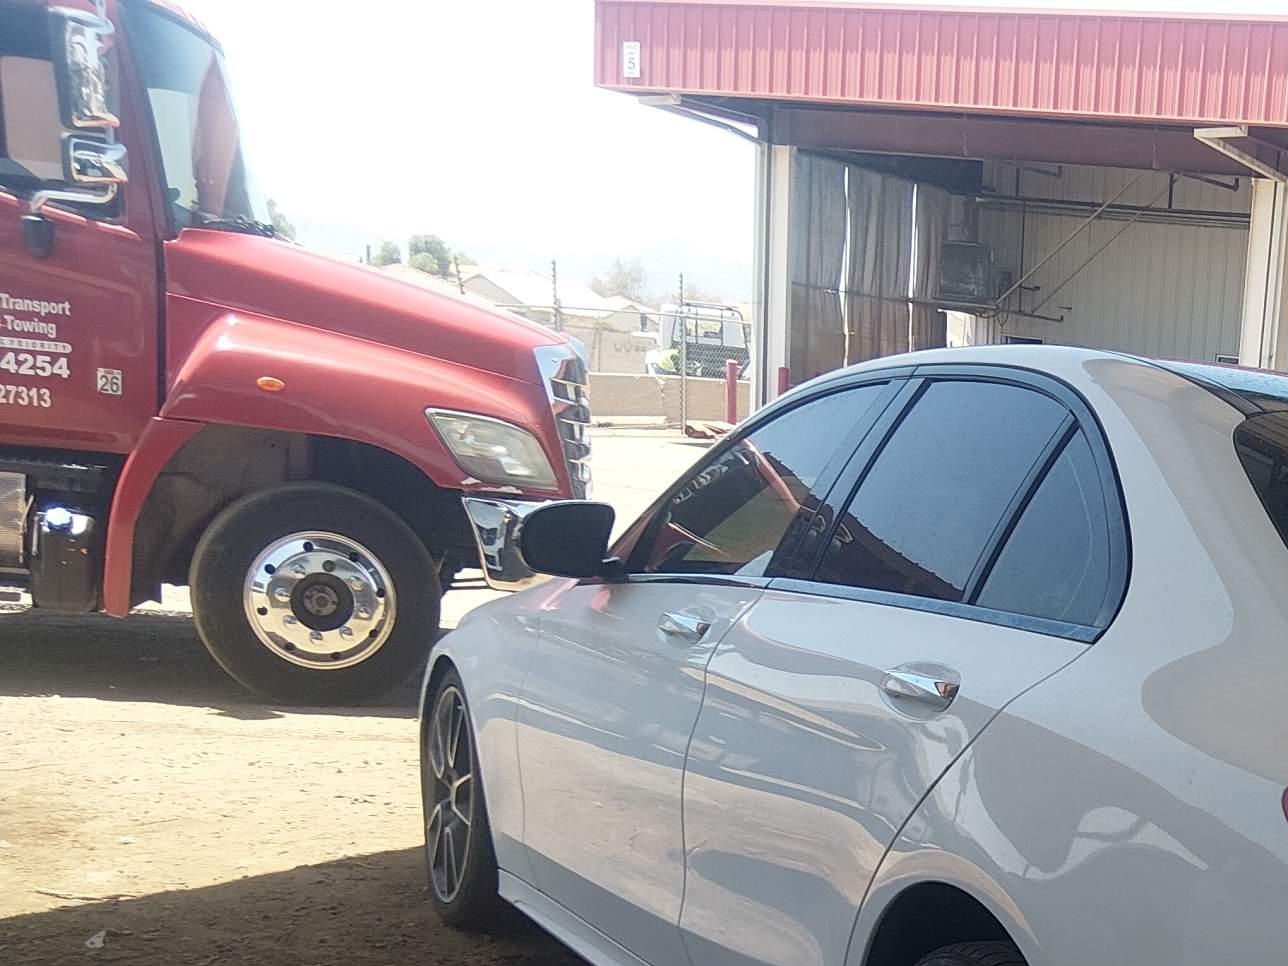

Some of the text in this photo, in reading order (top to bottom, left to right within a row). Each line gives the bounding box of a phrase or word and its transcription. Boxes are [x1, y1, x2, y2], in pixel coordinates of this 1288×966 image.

[0, 292, 71, 316] Transport
[4, 314, 57, 338] Towing
[0, 351, 70, 379] 4254
[99, 374, 120, 393] 26
